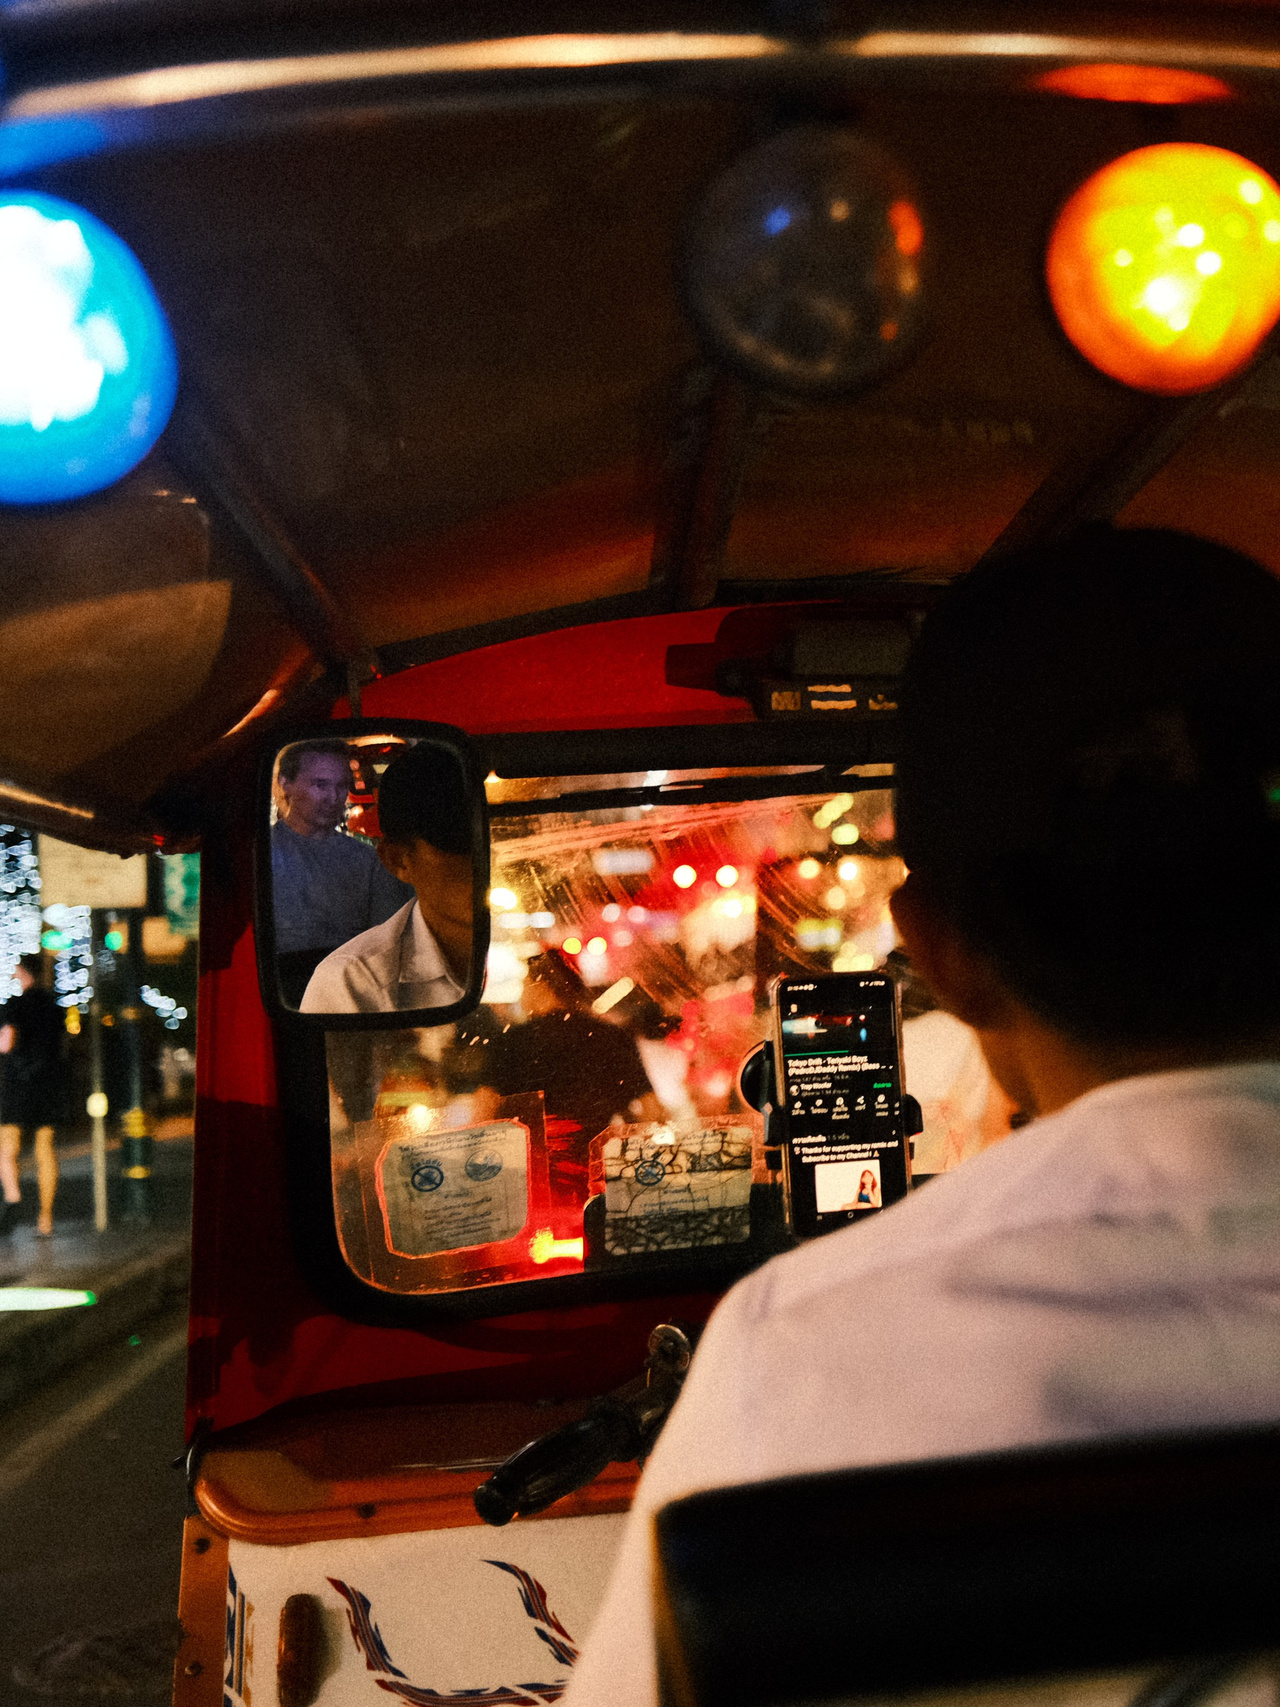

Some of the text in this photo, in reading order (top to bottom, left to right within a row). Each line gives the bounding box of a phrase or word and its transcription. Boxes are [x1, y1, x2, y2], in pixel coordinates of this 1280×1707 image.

[788, 1059, 807, 1068] Tokyo
[808, 1058, 822, 1066] Drift
[801, 1146, 822, 1155] Thanks
[822, 1145, 831, 1153] for
[831, 1143, 861, 1153] supporting
[862, 1143, 871, 1151] my
[887, 1139, 899, 1148] and
[801, 1154, 829, 1163] Subscribe
[836, 1153, 846, 1161] my
[846, 1151, 869, 1160] Channel
